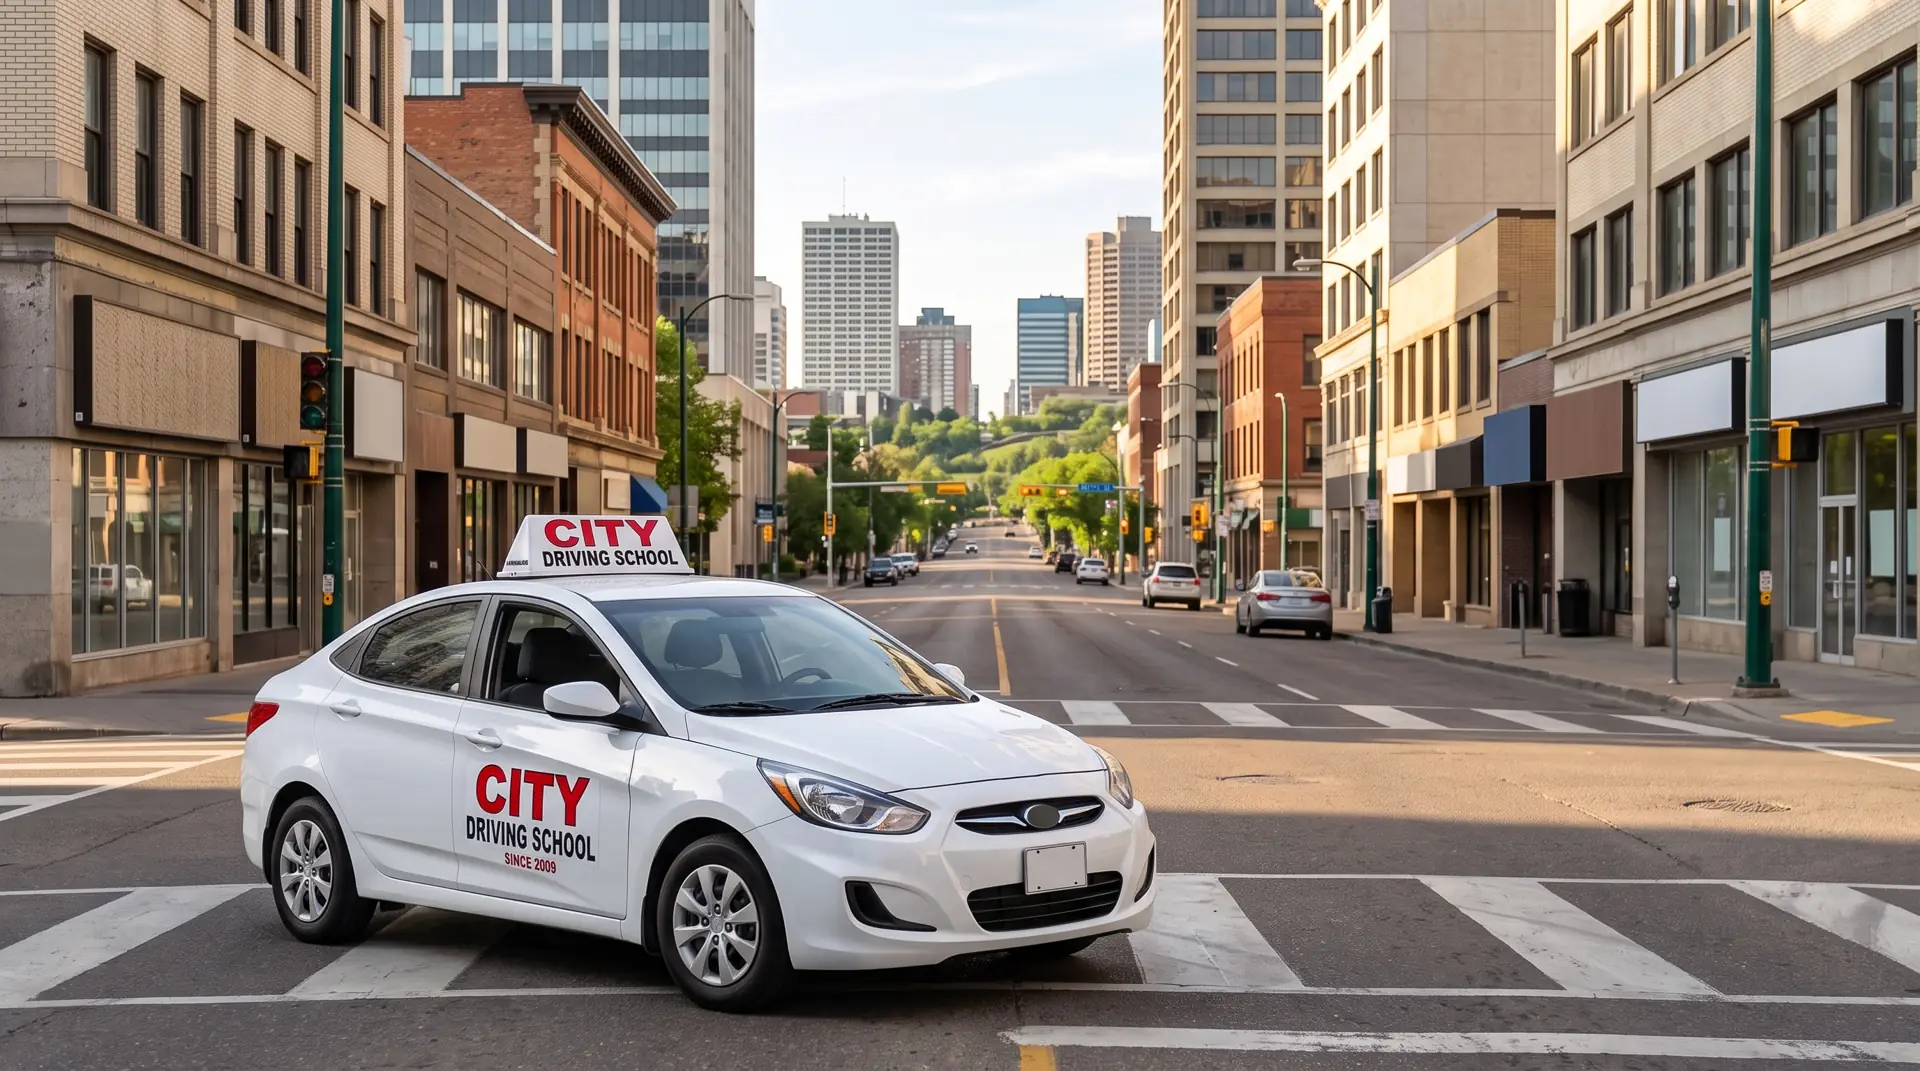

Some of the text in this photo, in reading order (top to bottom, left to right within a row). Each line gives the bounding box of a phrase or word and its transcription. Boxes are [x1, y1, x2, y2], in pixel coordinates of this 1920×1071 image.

[544, 519, 658, 547] CITY
[542, 549, 679, 567] DRIVING SCHOOL
[476, 764, 590, 827] CITY
[466, 815, 596, 862] DRIVING SCHOOL
[504, 852, 557, 874] SINCE 2009
